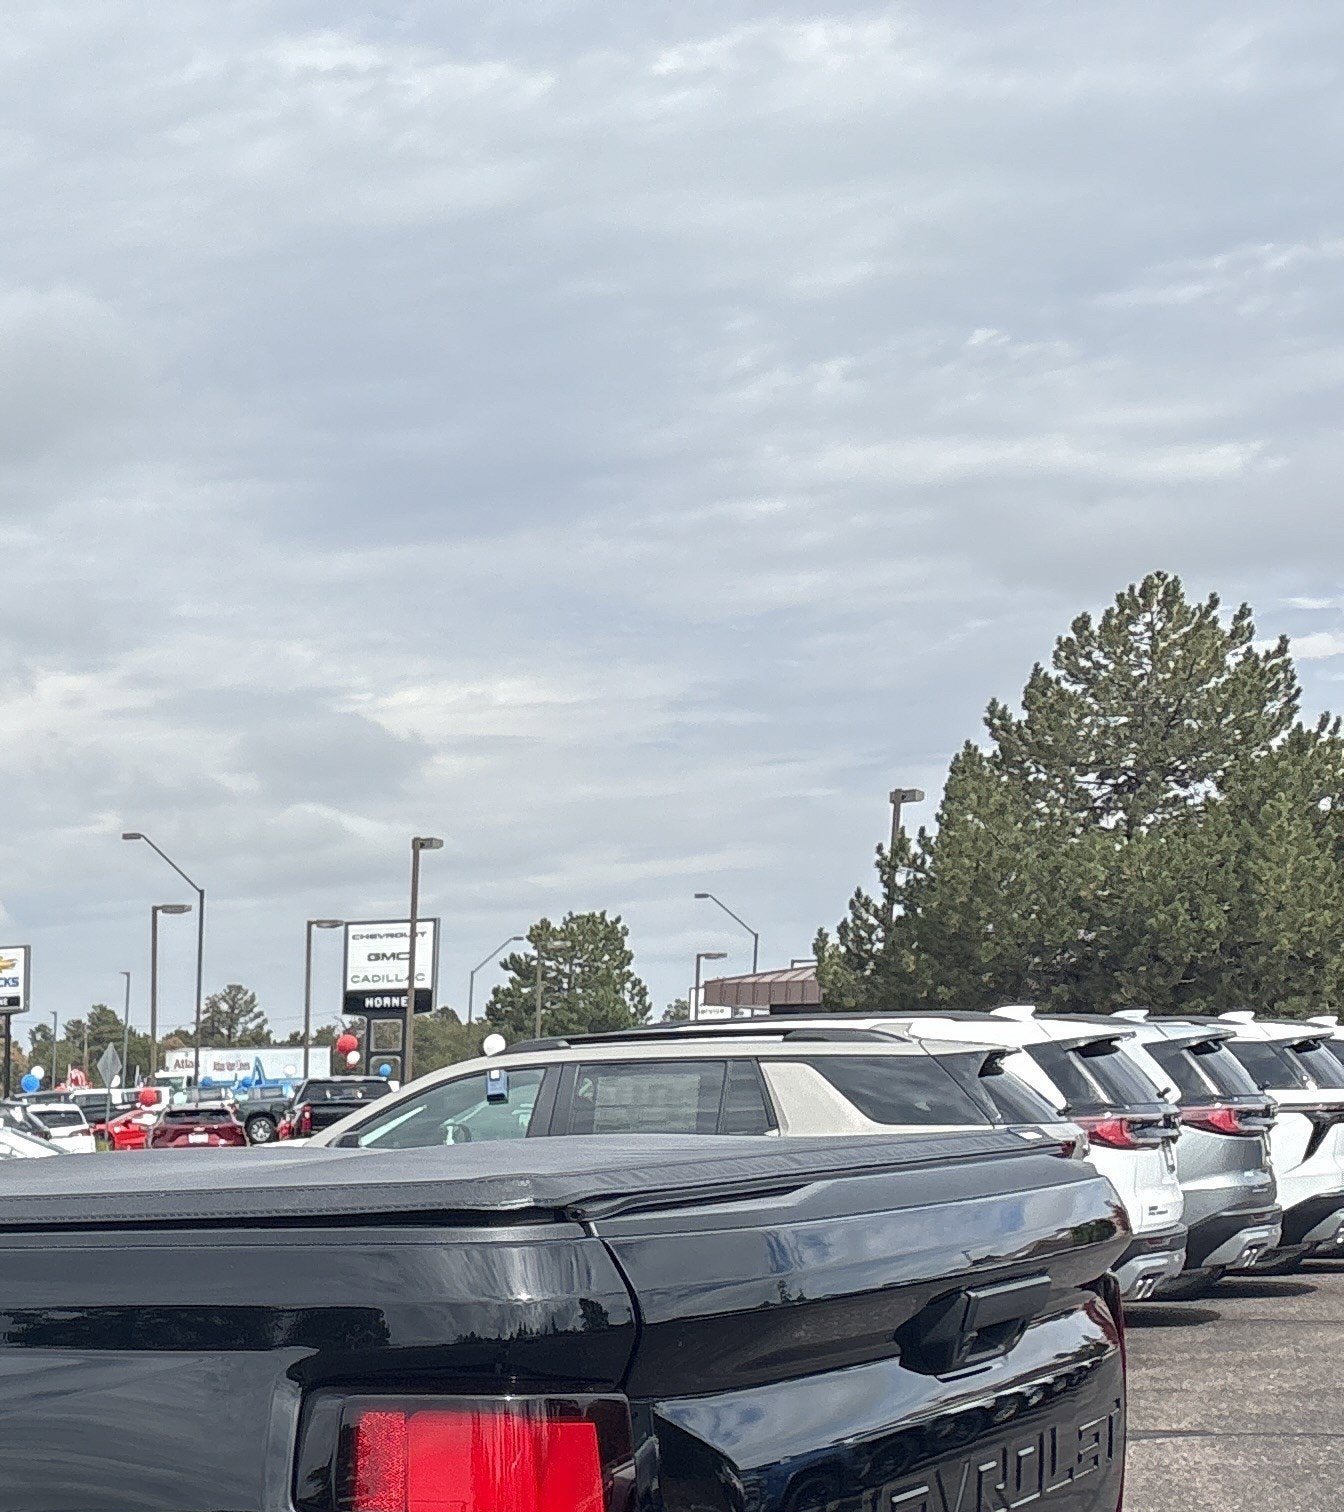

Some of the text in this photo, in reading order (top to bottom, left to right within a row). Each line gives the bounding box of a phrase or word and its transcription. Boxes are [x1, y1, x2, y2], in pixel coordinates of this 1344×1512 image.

[352, 931, 427, 940] CHEVROLT
[367, 952, 411, 962] GMC
[364, 996, 409, 1008] HORNE
[174, 1058, 200, 1070] Atla
